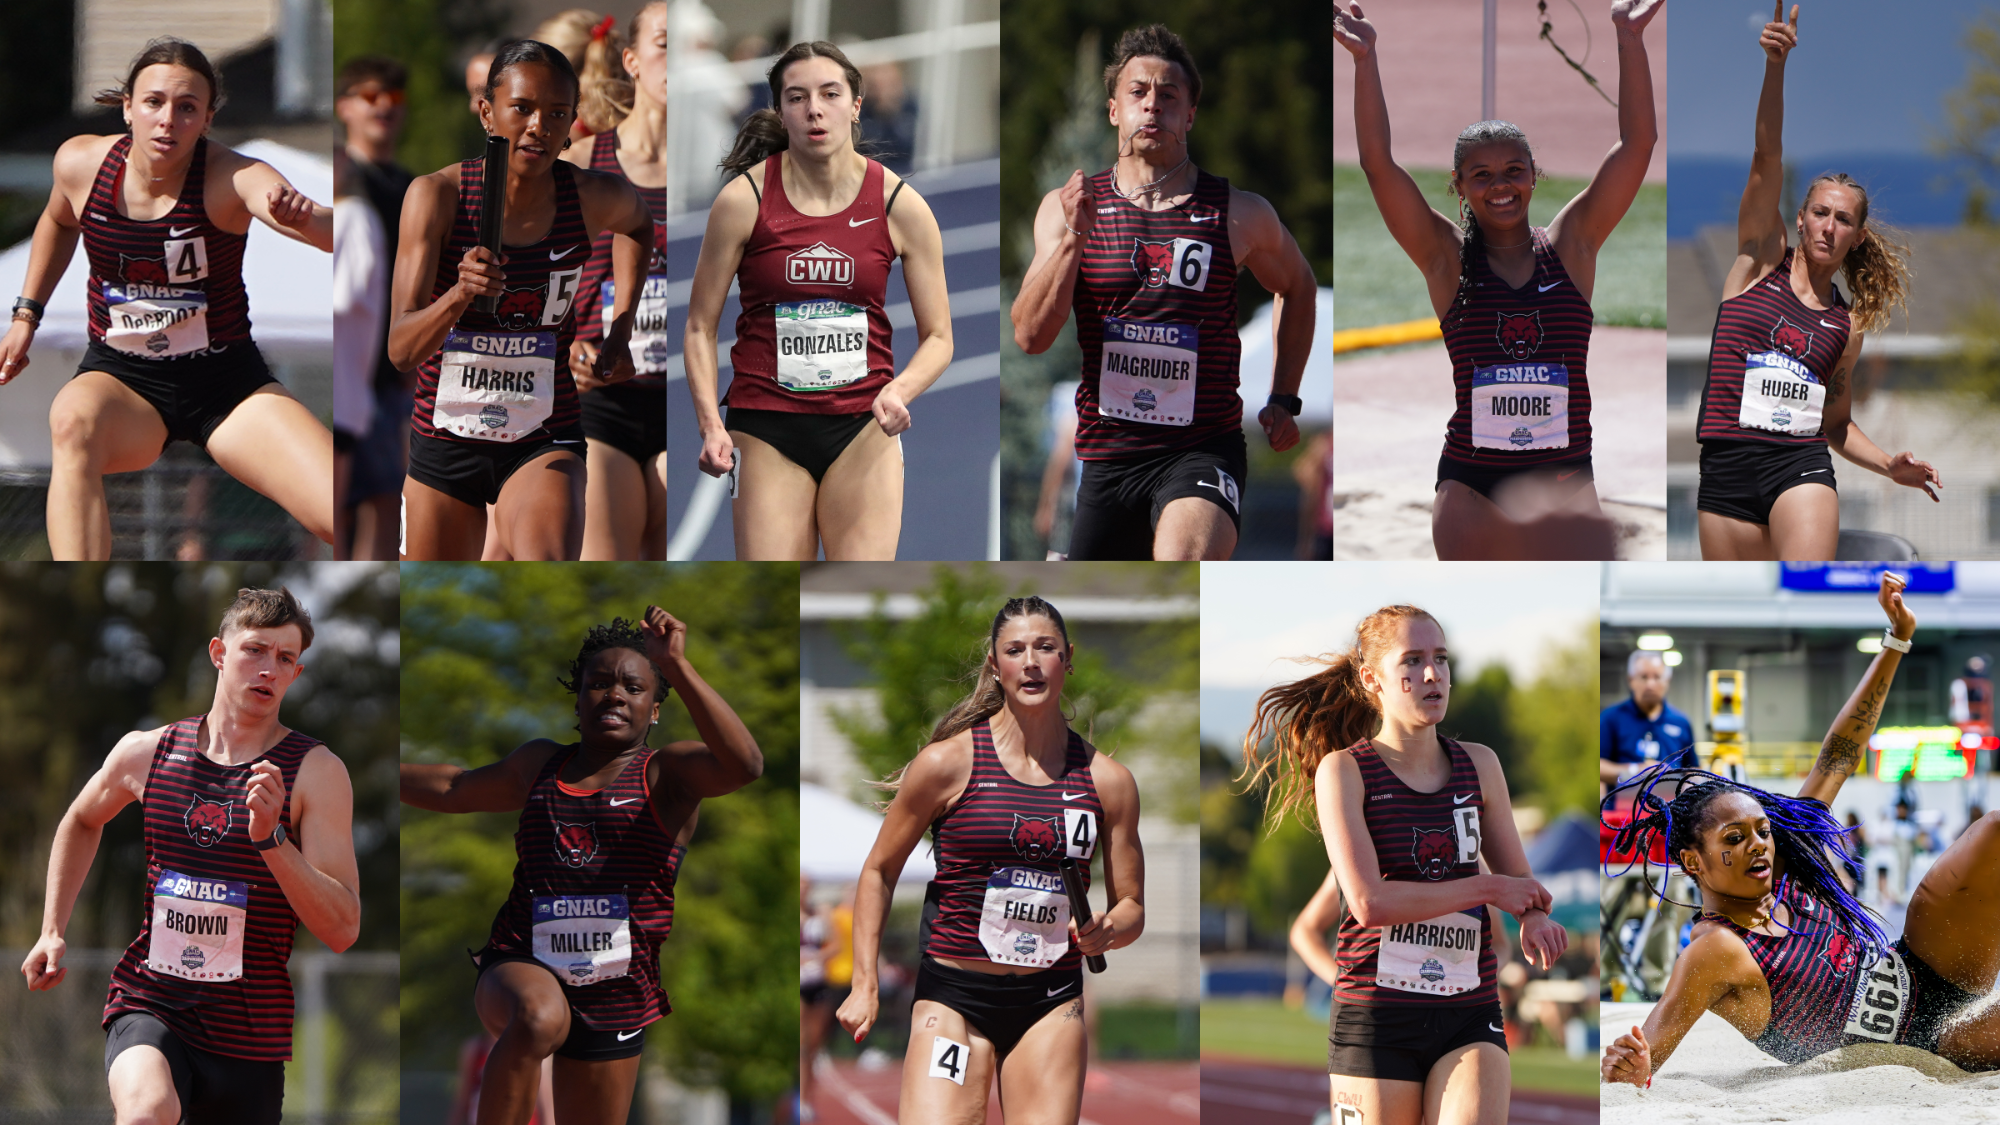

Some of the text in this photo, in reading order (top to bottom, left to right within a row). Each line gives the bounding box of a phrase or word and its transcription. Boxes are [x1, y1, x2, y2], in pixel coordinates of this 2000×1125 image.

[176, 242, 201, 279] 4
[790, 259, 850, 282] CWU
[1179, 243, 1204, 287] 6
[551, 273, 577, 322] 5
[797, 301, 846, 321] gnac
[471, 335, 537, 356] GNAC
[781, 332, 864, 356] GONZALES
[1123, 324, 1179, 344] GNAC
[1107, 352, 1190, 381] MAGRUDER
[1495, 366, 1550, 382] GNAC
[1765, 353, 1809, 379] GNAC
[461, 365, 535, 393] HARRIS
[1761, 379, 1809, 401] HUBER
[1491, 396, 1551, 416] MOORE
[1223, 473, 1236, 504] 6
[1401, 677, 1411, 693] C
[1371, 793, 1393, 801] CENTRAL
[1072, 813, 1092, 857] 4
[1462, 811, 1480, 861] 5
[1721, 850, 1733, 867] C
[173, 877, 227, 901] GNAC
[1011, 869, 1062, 891] GNAC
[553, 899, 610, 917] GNAC
[1003, 900, 1057, 925] FIELDS
[166, 909, 228, 935] BROWN
[551, 932, 613, 953] MILLER
[1389, 922, 1476, 951] HARRISON
[925, 1016, 938, 1028] C
[938, 1043, 960, 1079] 4
[1337, 1091, 1363, 1107] CWU
